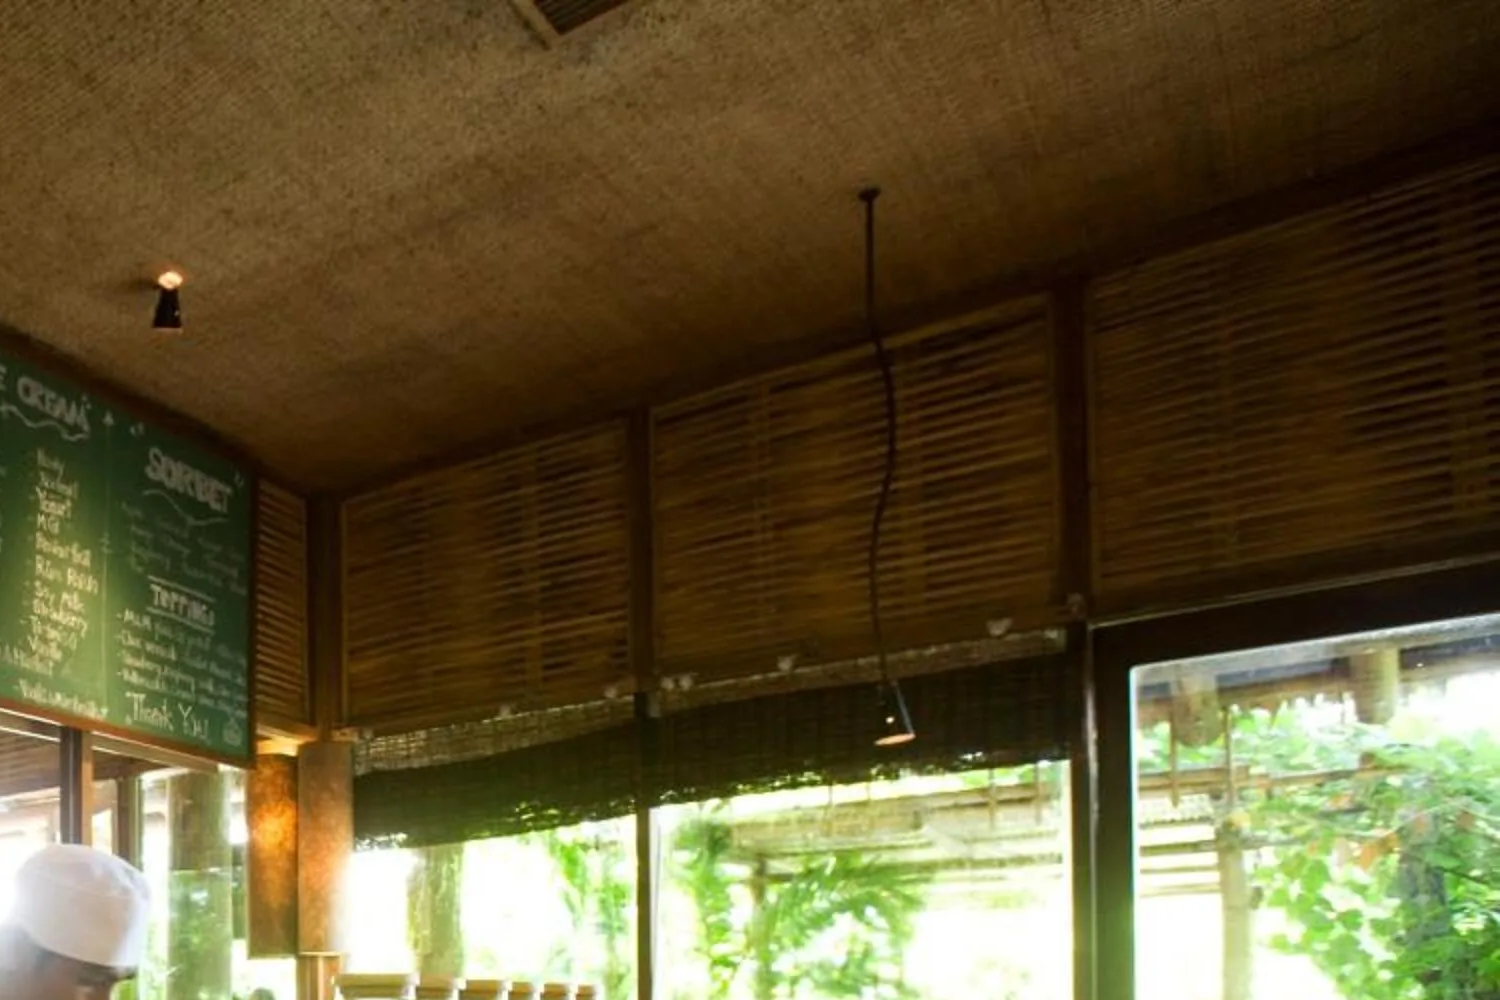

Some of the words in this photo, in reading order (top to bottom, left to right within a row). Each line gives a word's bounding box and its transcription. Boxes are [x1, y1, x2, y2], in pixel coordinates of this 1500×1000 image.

[16, 375, 92, 434] CREAM
[144, 446, 233, 514] SORBET
[125, 691, 174, 732] Thank
